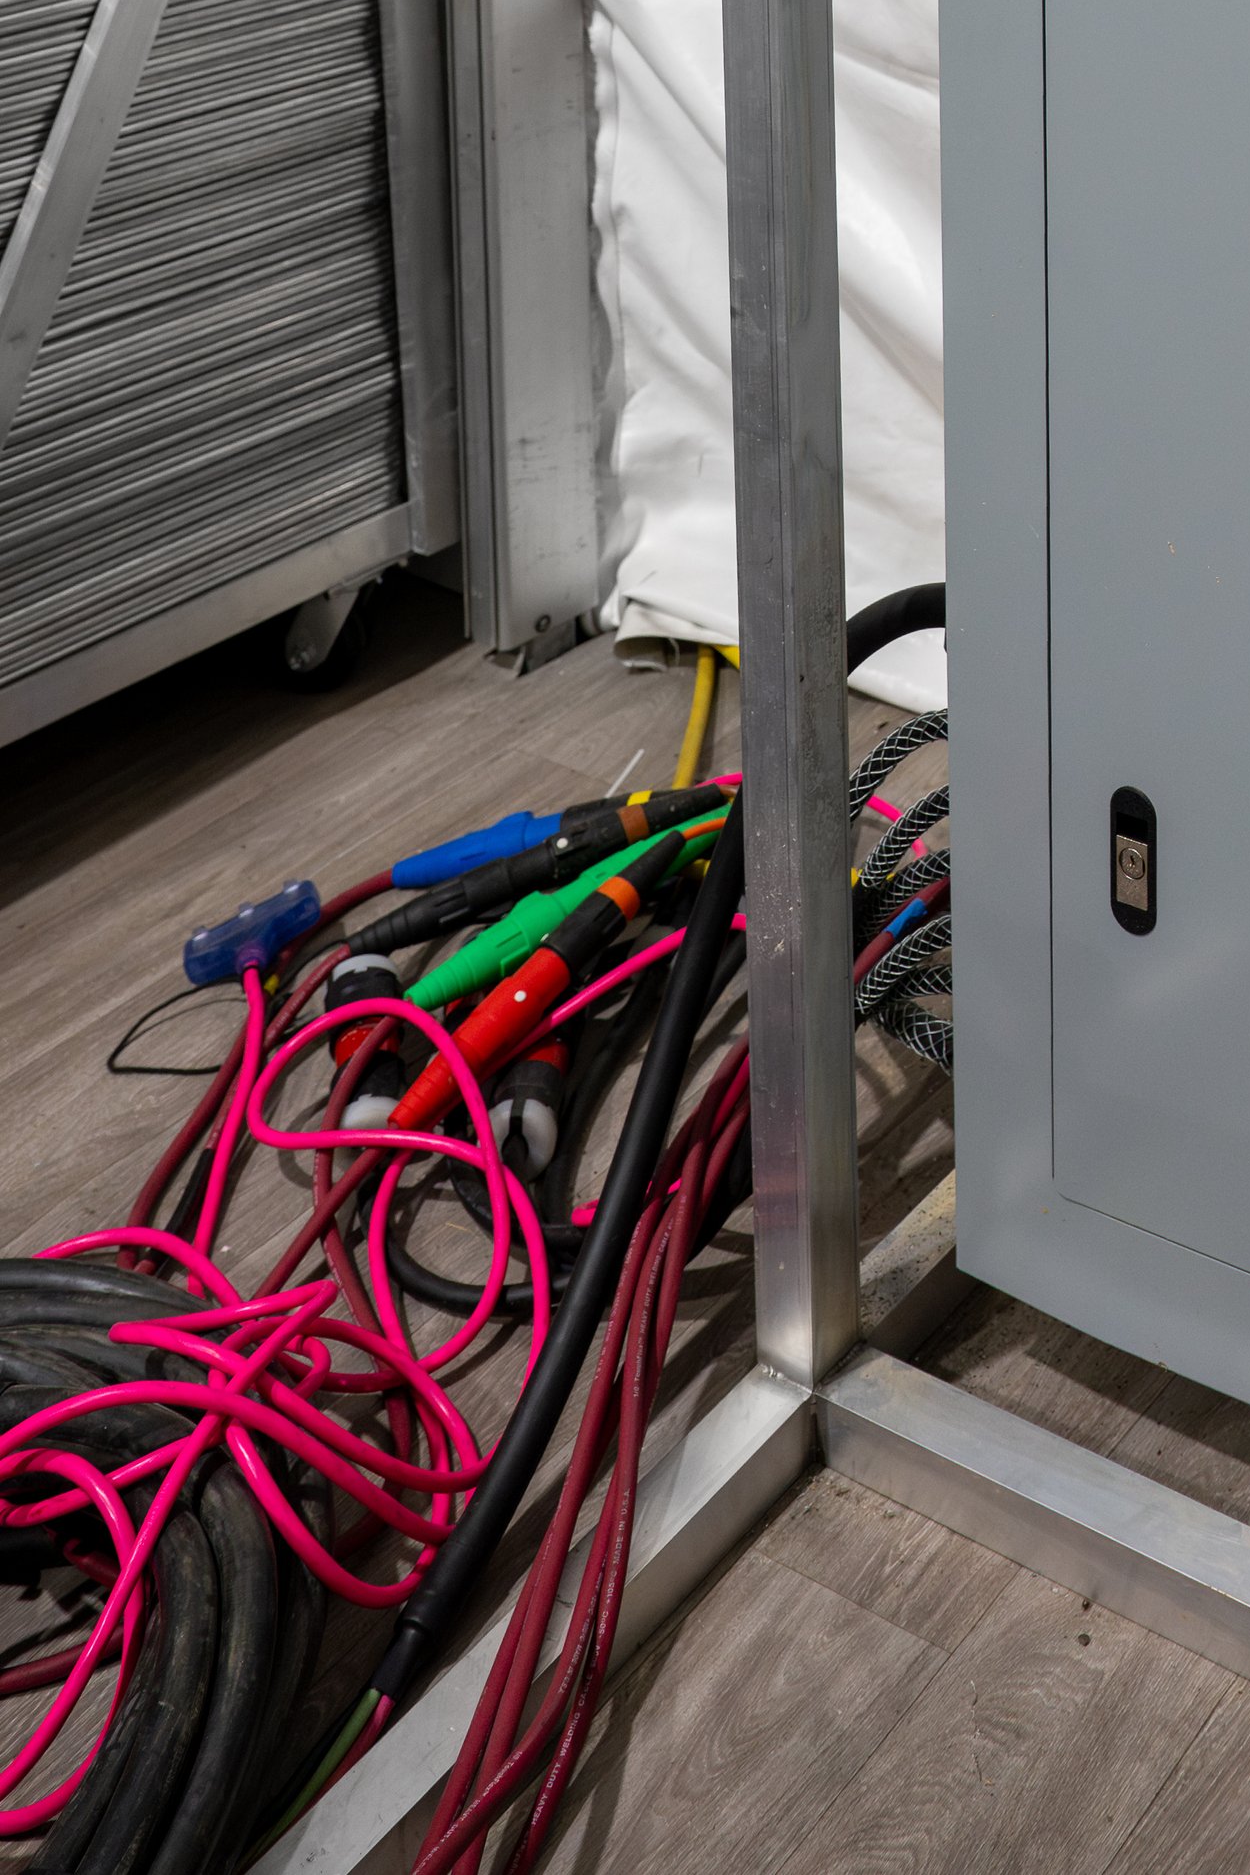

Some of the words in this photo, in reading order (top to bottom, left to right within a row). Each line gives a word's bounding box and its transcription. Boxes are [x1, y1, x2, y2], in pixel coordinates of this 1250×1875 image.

[643, 1286, 652, 1307] DUTY
[638, 1312, 649, 1335] HEAVY
[530, 1792, 549, 1827] HEAVY
[545, 1761, 562, 1790] DUTY
[559, 1711, 582, 1758] WELDING
[612, 1535, 624, 1566] MADE
[618, 1520, 626, 1532] IN
